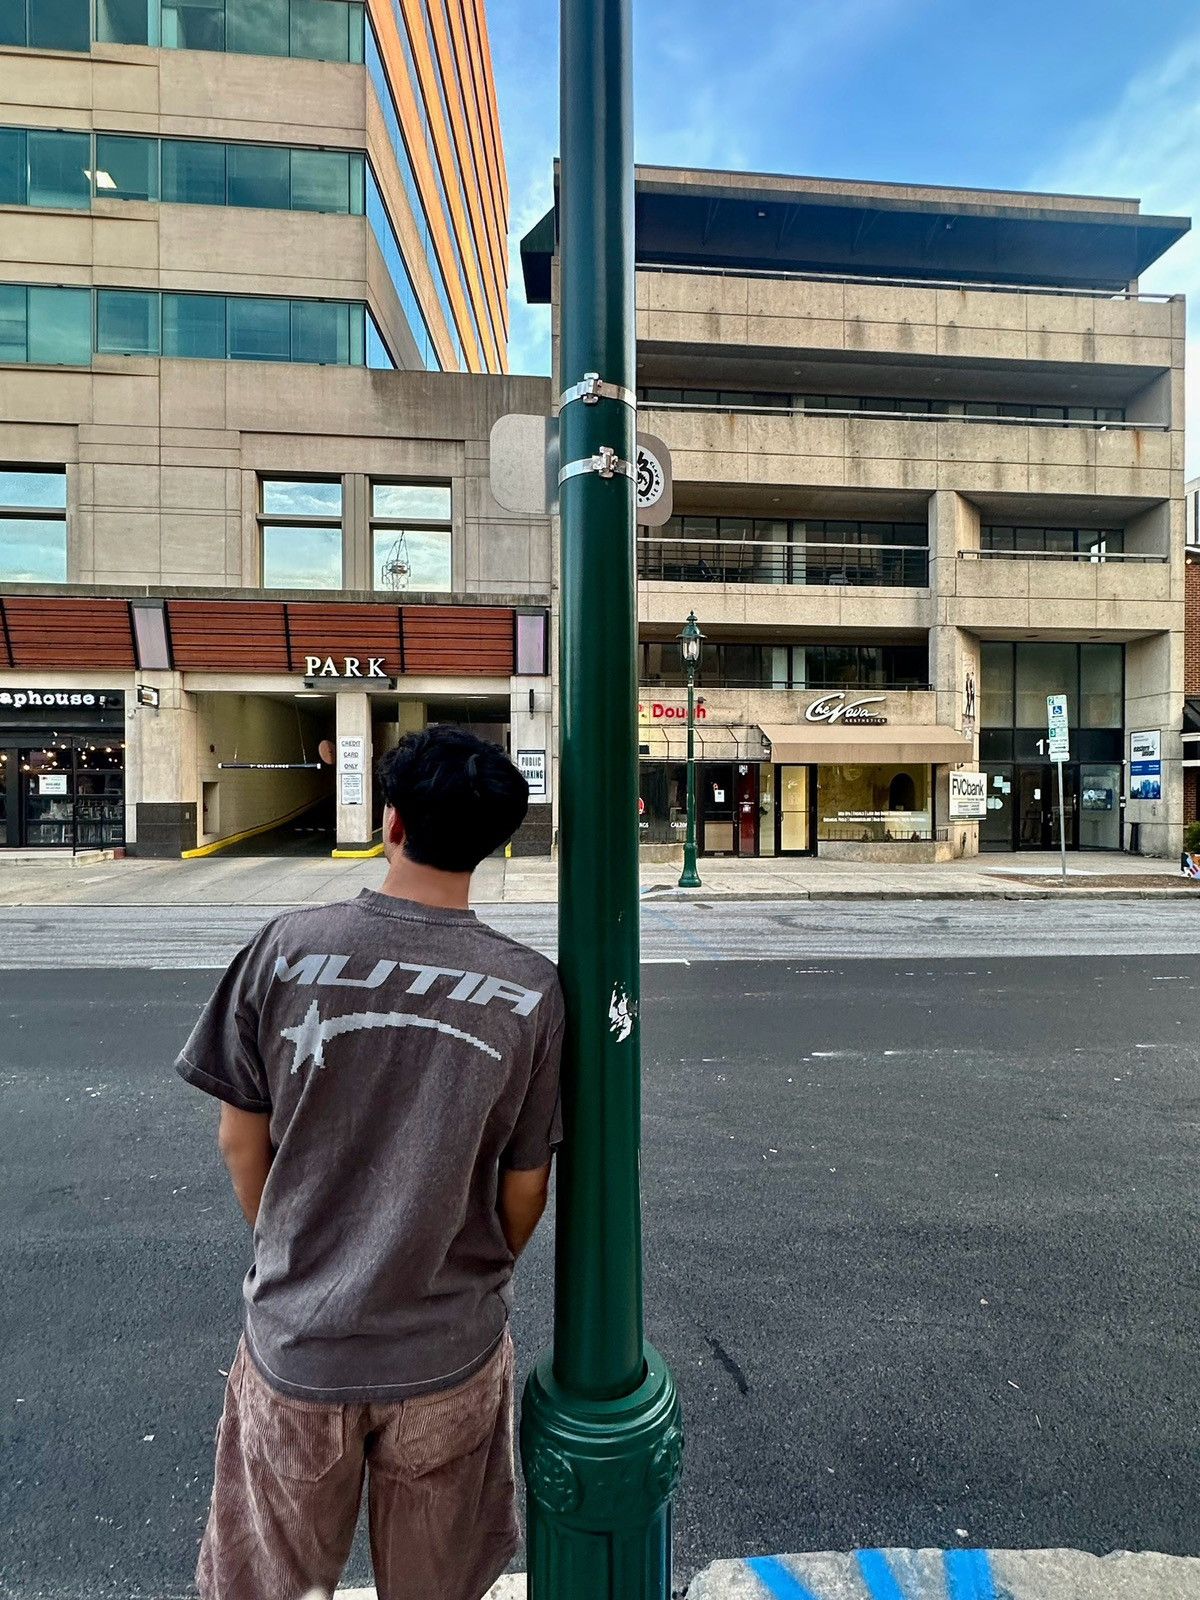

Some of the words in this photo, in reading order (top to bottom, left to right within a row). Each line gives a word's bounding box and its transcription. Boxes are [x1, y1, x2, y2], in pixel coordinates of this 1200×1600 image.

[304, 656, 388, 678] PARK
[341, 740, 361, 748] CREDIT
[343, 751, 359, 759] CARD
[522, 756, 541, 766] PUBLIC
[952, 777, 985, 797] FVCbank
